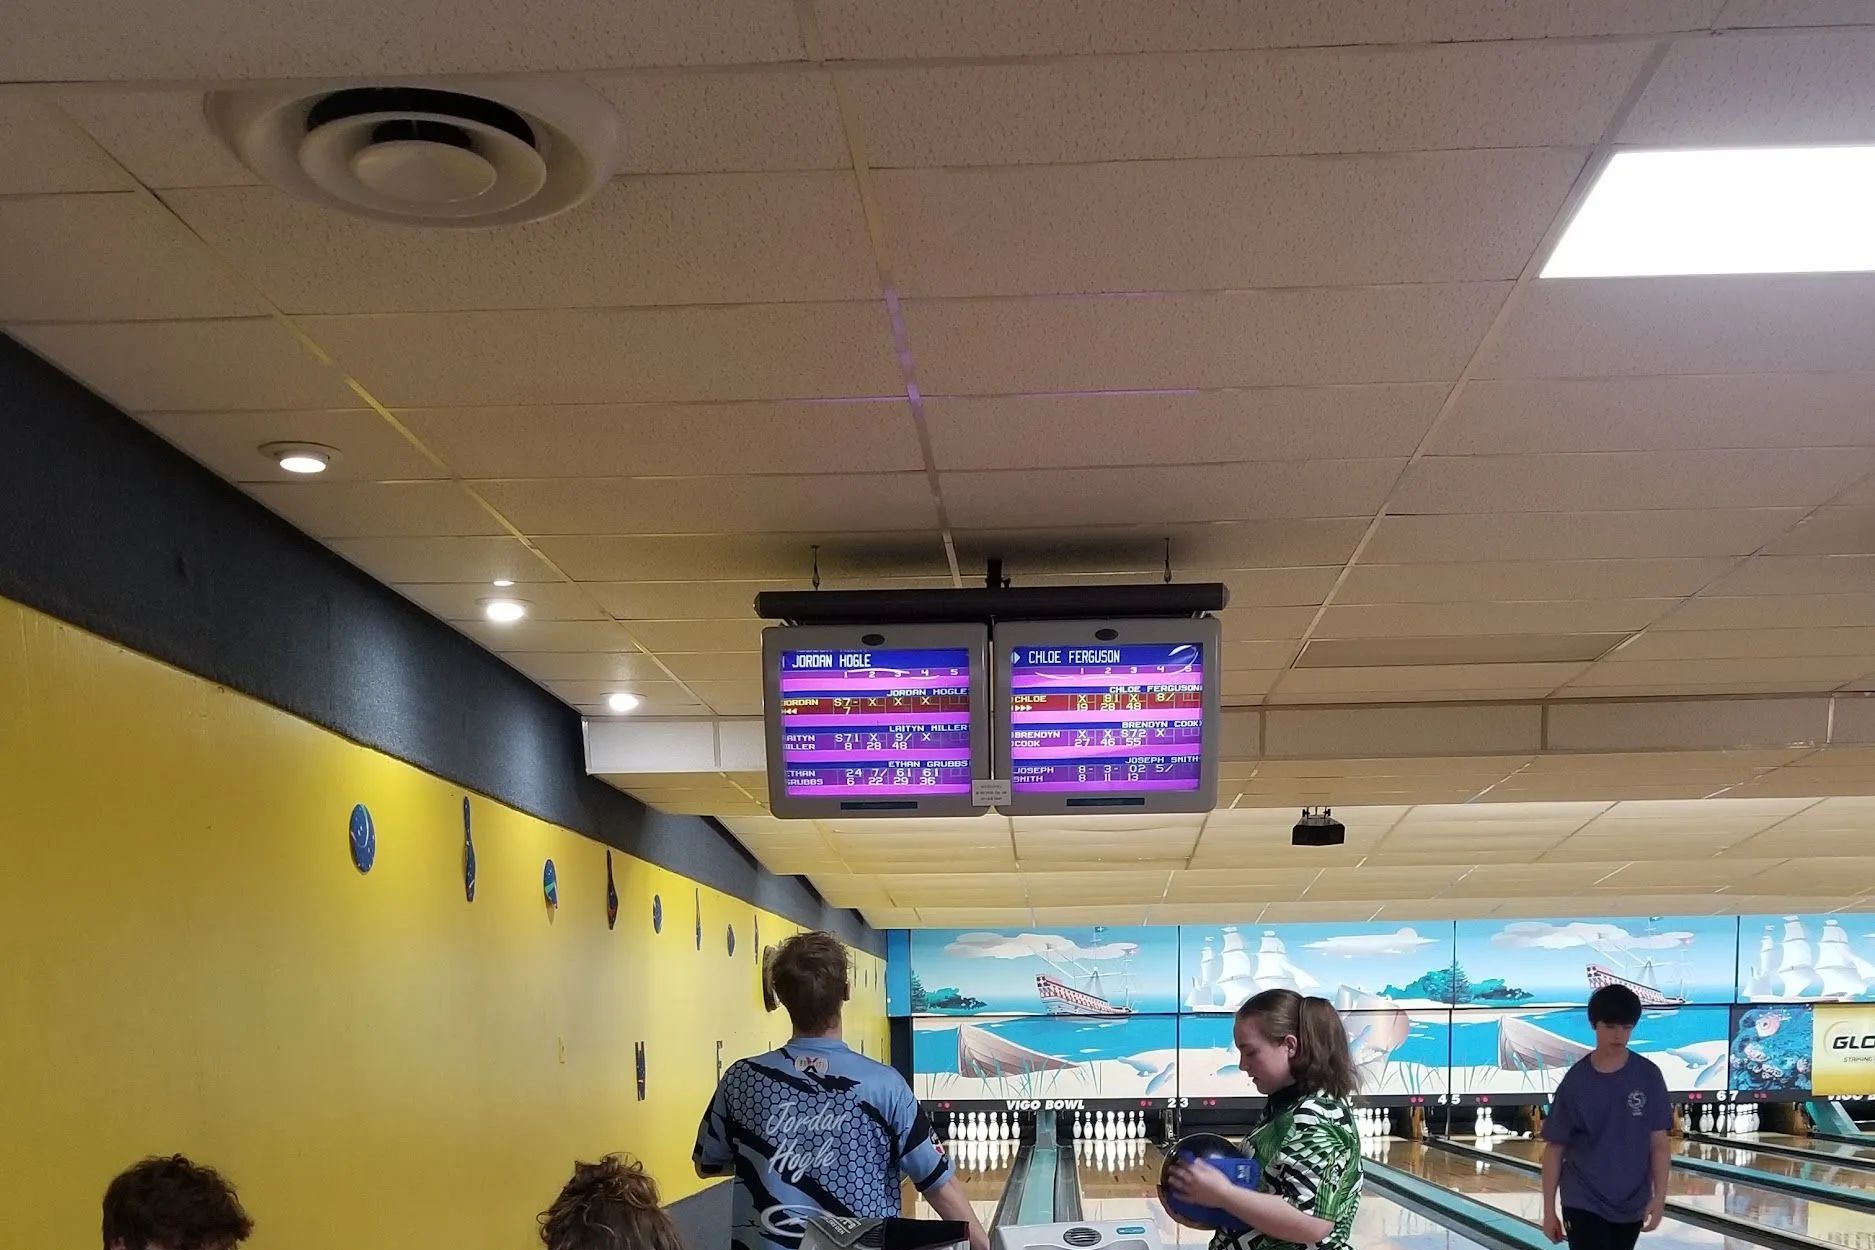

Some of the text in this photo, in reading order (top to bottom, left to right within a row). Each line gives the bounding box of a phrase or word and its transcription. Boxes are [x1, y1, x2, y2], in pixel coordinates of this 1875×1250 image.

[792, 654, 871, 668] JORDAN HOGLE
[1028, 650, 1120, 664] CHLOE FERGUSON
[1130, 666, 1138, 674] 3
[887, 689, 926, 697] JORDAN
[868, 698, 877, 706] X
[894, 697, 902, 706] X
[921, 696, 930, 705] X
[1078, 695, 1087, 703] X
[1130, 694, 1138, 702] X
[843, 707, 851, 715] 7
[1077, 703, 1142, 712] 19 28 48
[931, 724, 968, 732] MILLER
[1122, 721, 1168, 729] BRENDYN
[869, 733, 878, 741] X
[922, 732, 931, 741] X
[1078, 730, 1087, 738] X
[1104, 729, 1112, 738] X
[1156, 729, 1165, 737] X
[867, 742, 882, 750] 28
[892, 742, 908, 750] 48
[1074, 739, 1090, 747] 27
[1100, 738, 1116, 746] 46
[1126, 738, 1142, 746] 55
[846, 769, 862, 777] 24
[1078, 774, 1086, 782] 8
[1104, 774, 1111, 782] 11
[1128, 773, 1139, 782] 13
[847, 778, 855, 786] 6
[868, 777, 884, 786] 22
[893, 777, 909, 786] 29
[920, 777, 936, 786] 36
[1438, 1094, 1447, 1105] 4
[1451, 1094, 1460, 1105] 5
[1716, 1090, 1726, 1101] 6
[1729, 1090, 1739, 1101] 7
[1006, 1100, 1085, 1110] VIGO BOWL
[1167, 1097, 1176, 1108] 2
[1179, 1097, 1189, 1108] 3
[766, 1101, 846, 1135] Jordan
[768, 1137, 837, 1183] Hogle
